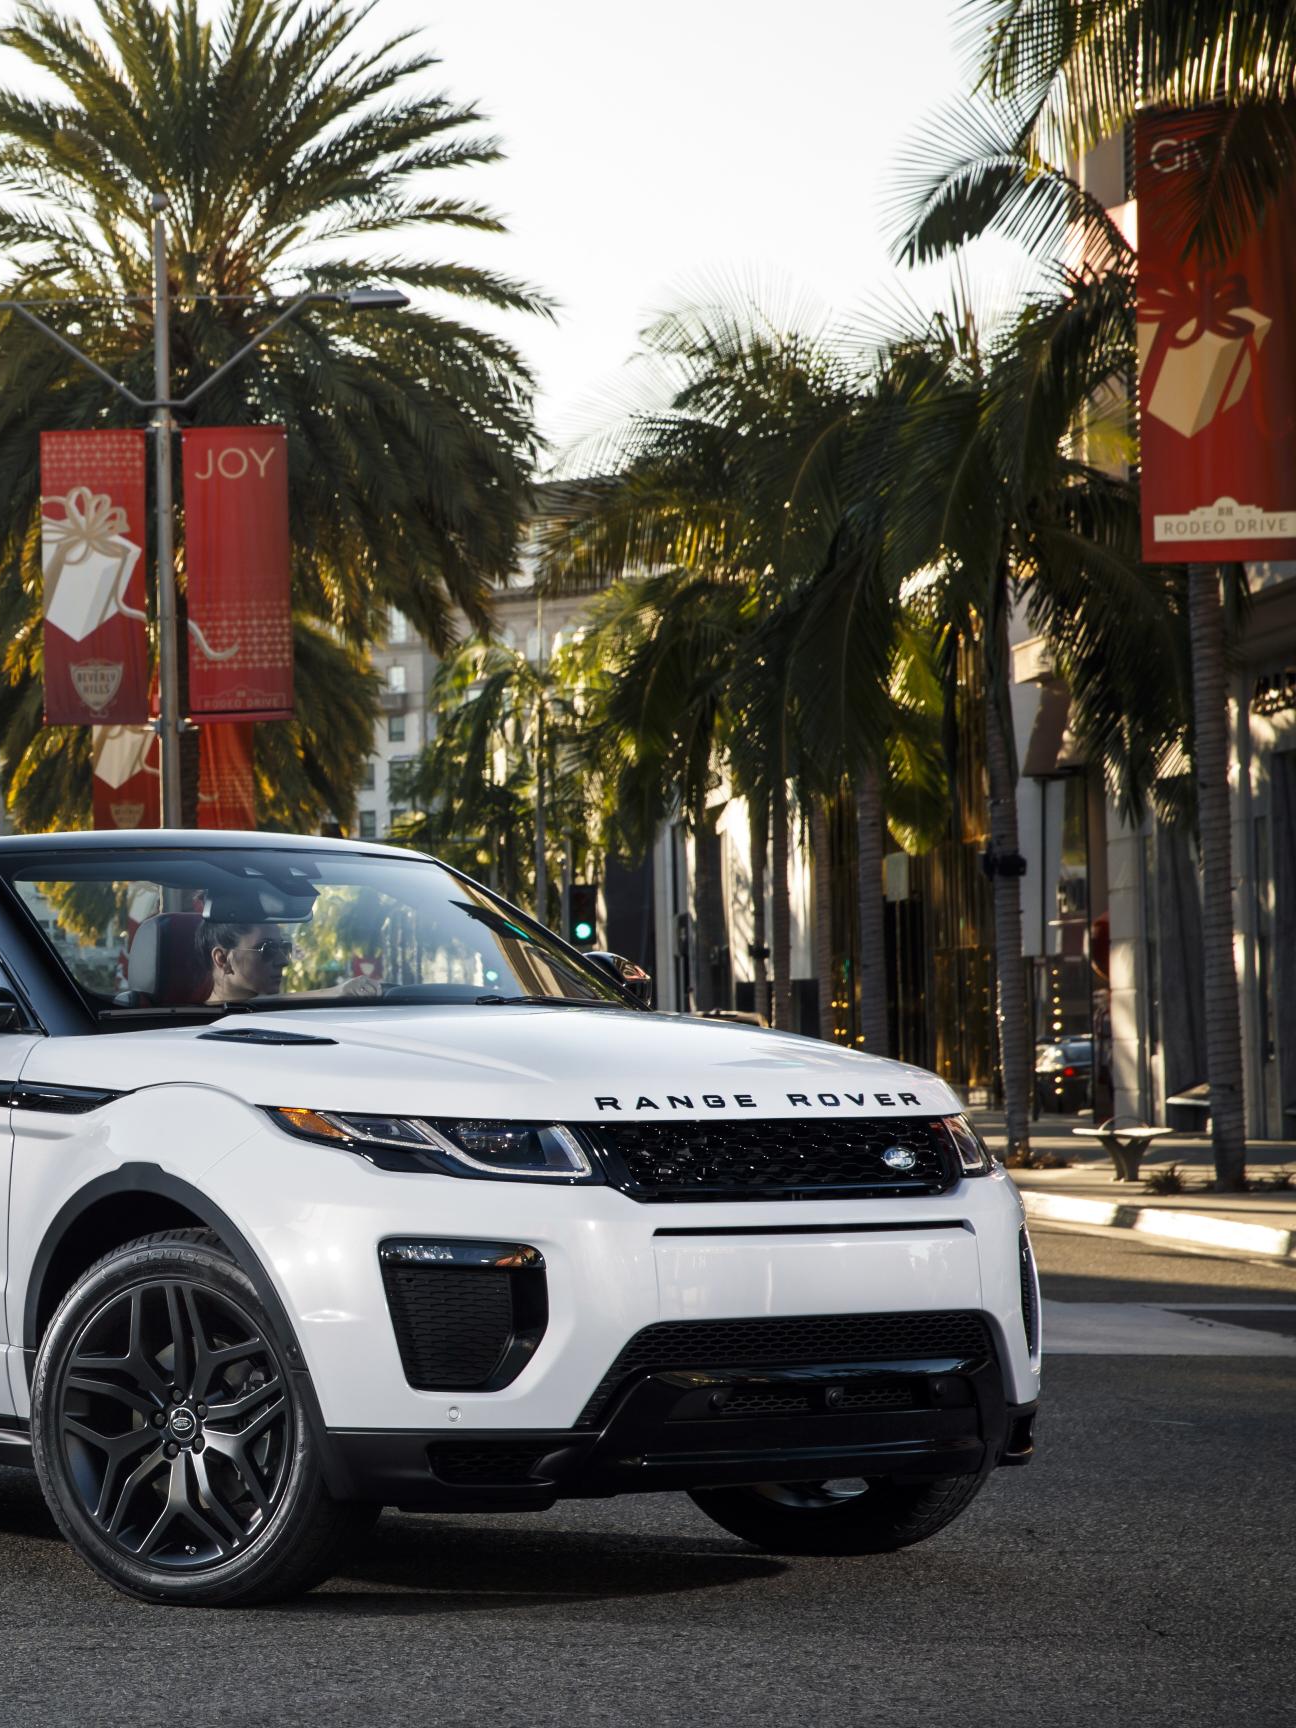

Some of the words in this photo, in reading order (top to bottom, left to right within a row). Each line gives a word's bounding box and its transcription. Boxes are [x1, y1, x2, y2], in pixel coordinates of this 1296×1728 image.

[194, 447, 275, 480] JOY
[1163, 519, 1226, 536] RODEO
[1234, 517, 1288, 534] DRIVE
[77, 672, 116, 683] BEVERLY
[83, 684, 110, 695] HILLS
[594, 1094, 757, 1111] RANGE
[786, 1092, 921, 1107] ROVER
